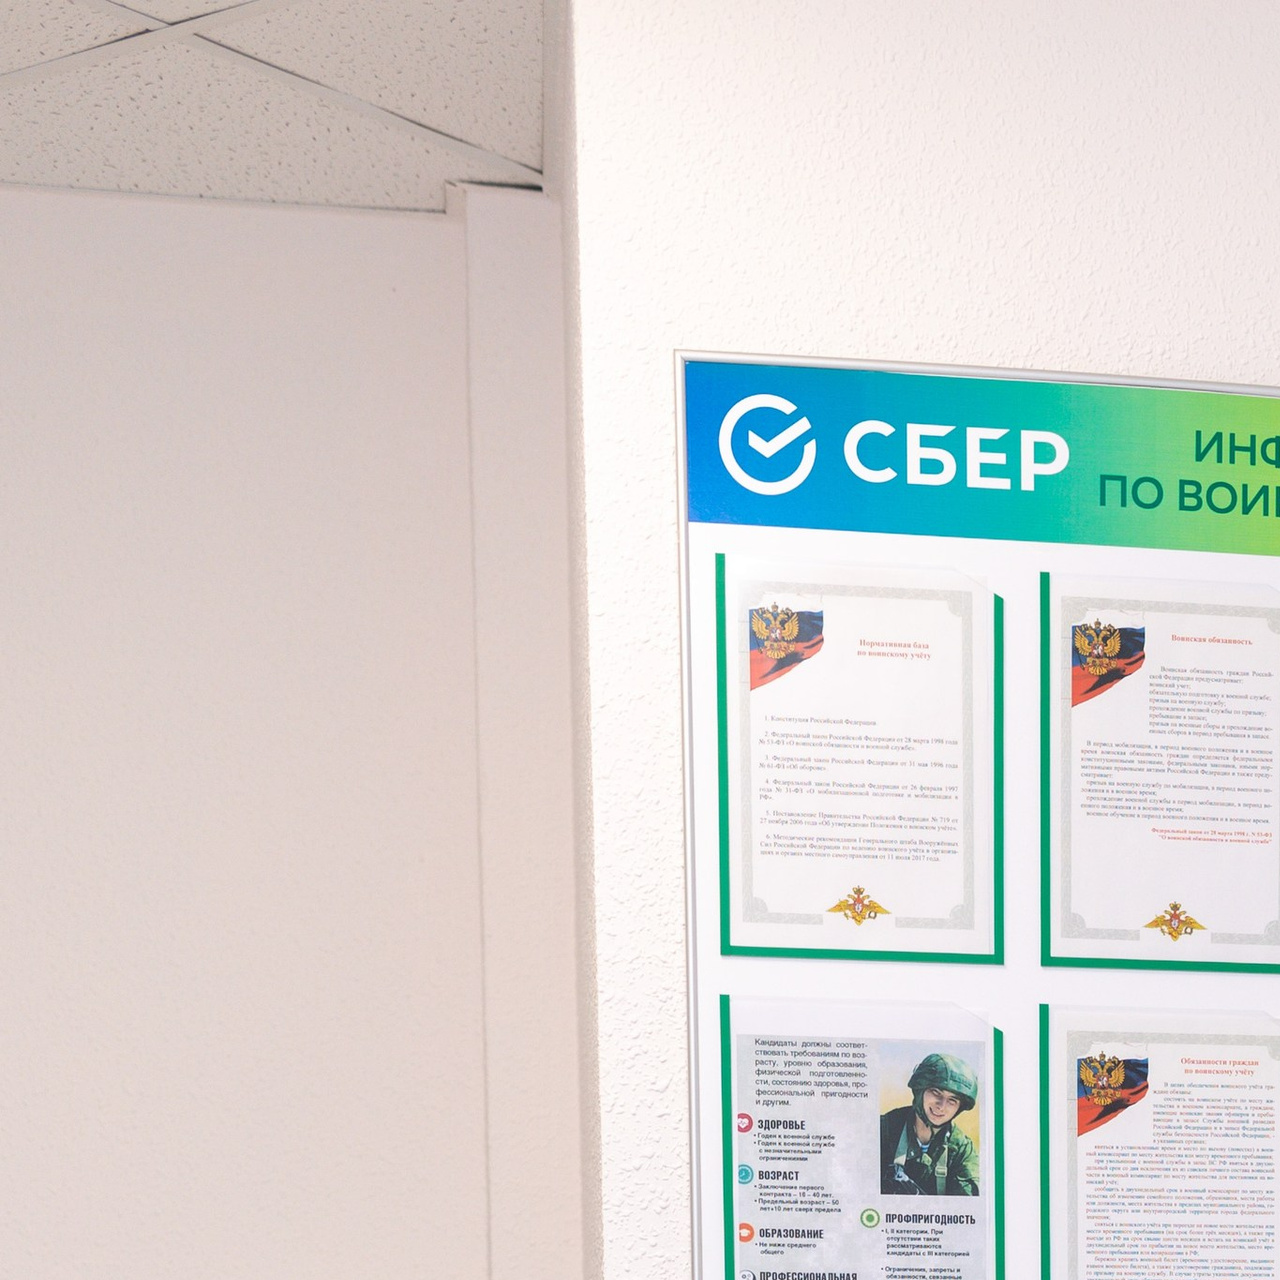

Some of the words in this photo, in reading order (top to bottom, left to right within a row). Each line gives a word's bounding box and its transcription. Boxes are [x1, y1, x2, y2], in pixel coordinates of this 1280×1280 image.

[843, 420, 1070, 491] СБЕР
[1099, 474, 1163, 510] ПО
[859, 639, 911, 648] Нормативная
[1208, 636, 1252, 644] обязанность
[1229, 1060, 1258, 1069] граждан
[758, 1119, 805, 1130] ЗДОРОВЬЕ
[758, 1170, 799, 1180] ВОЗРАСТ
[885, 1213, 975, 1225] ПРОФПРИГОДНОСТЬ
[759, 1228, 823, 1238] ОБРАЗОВАНИЕ
